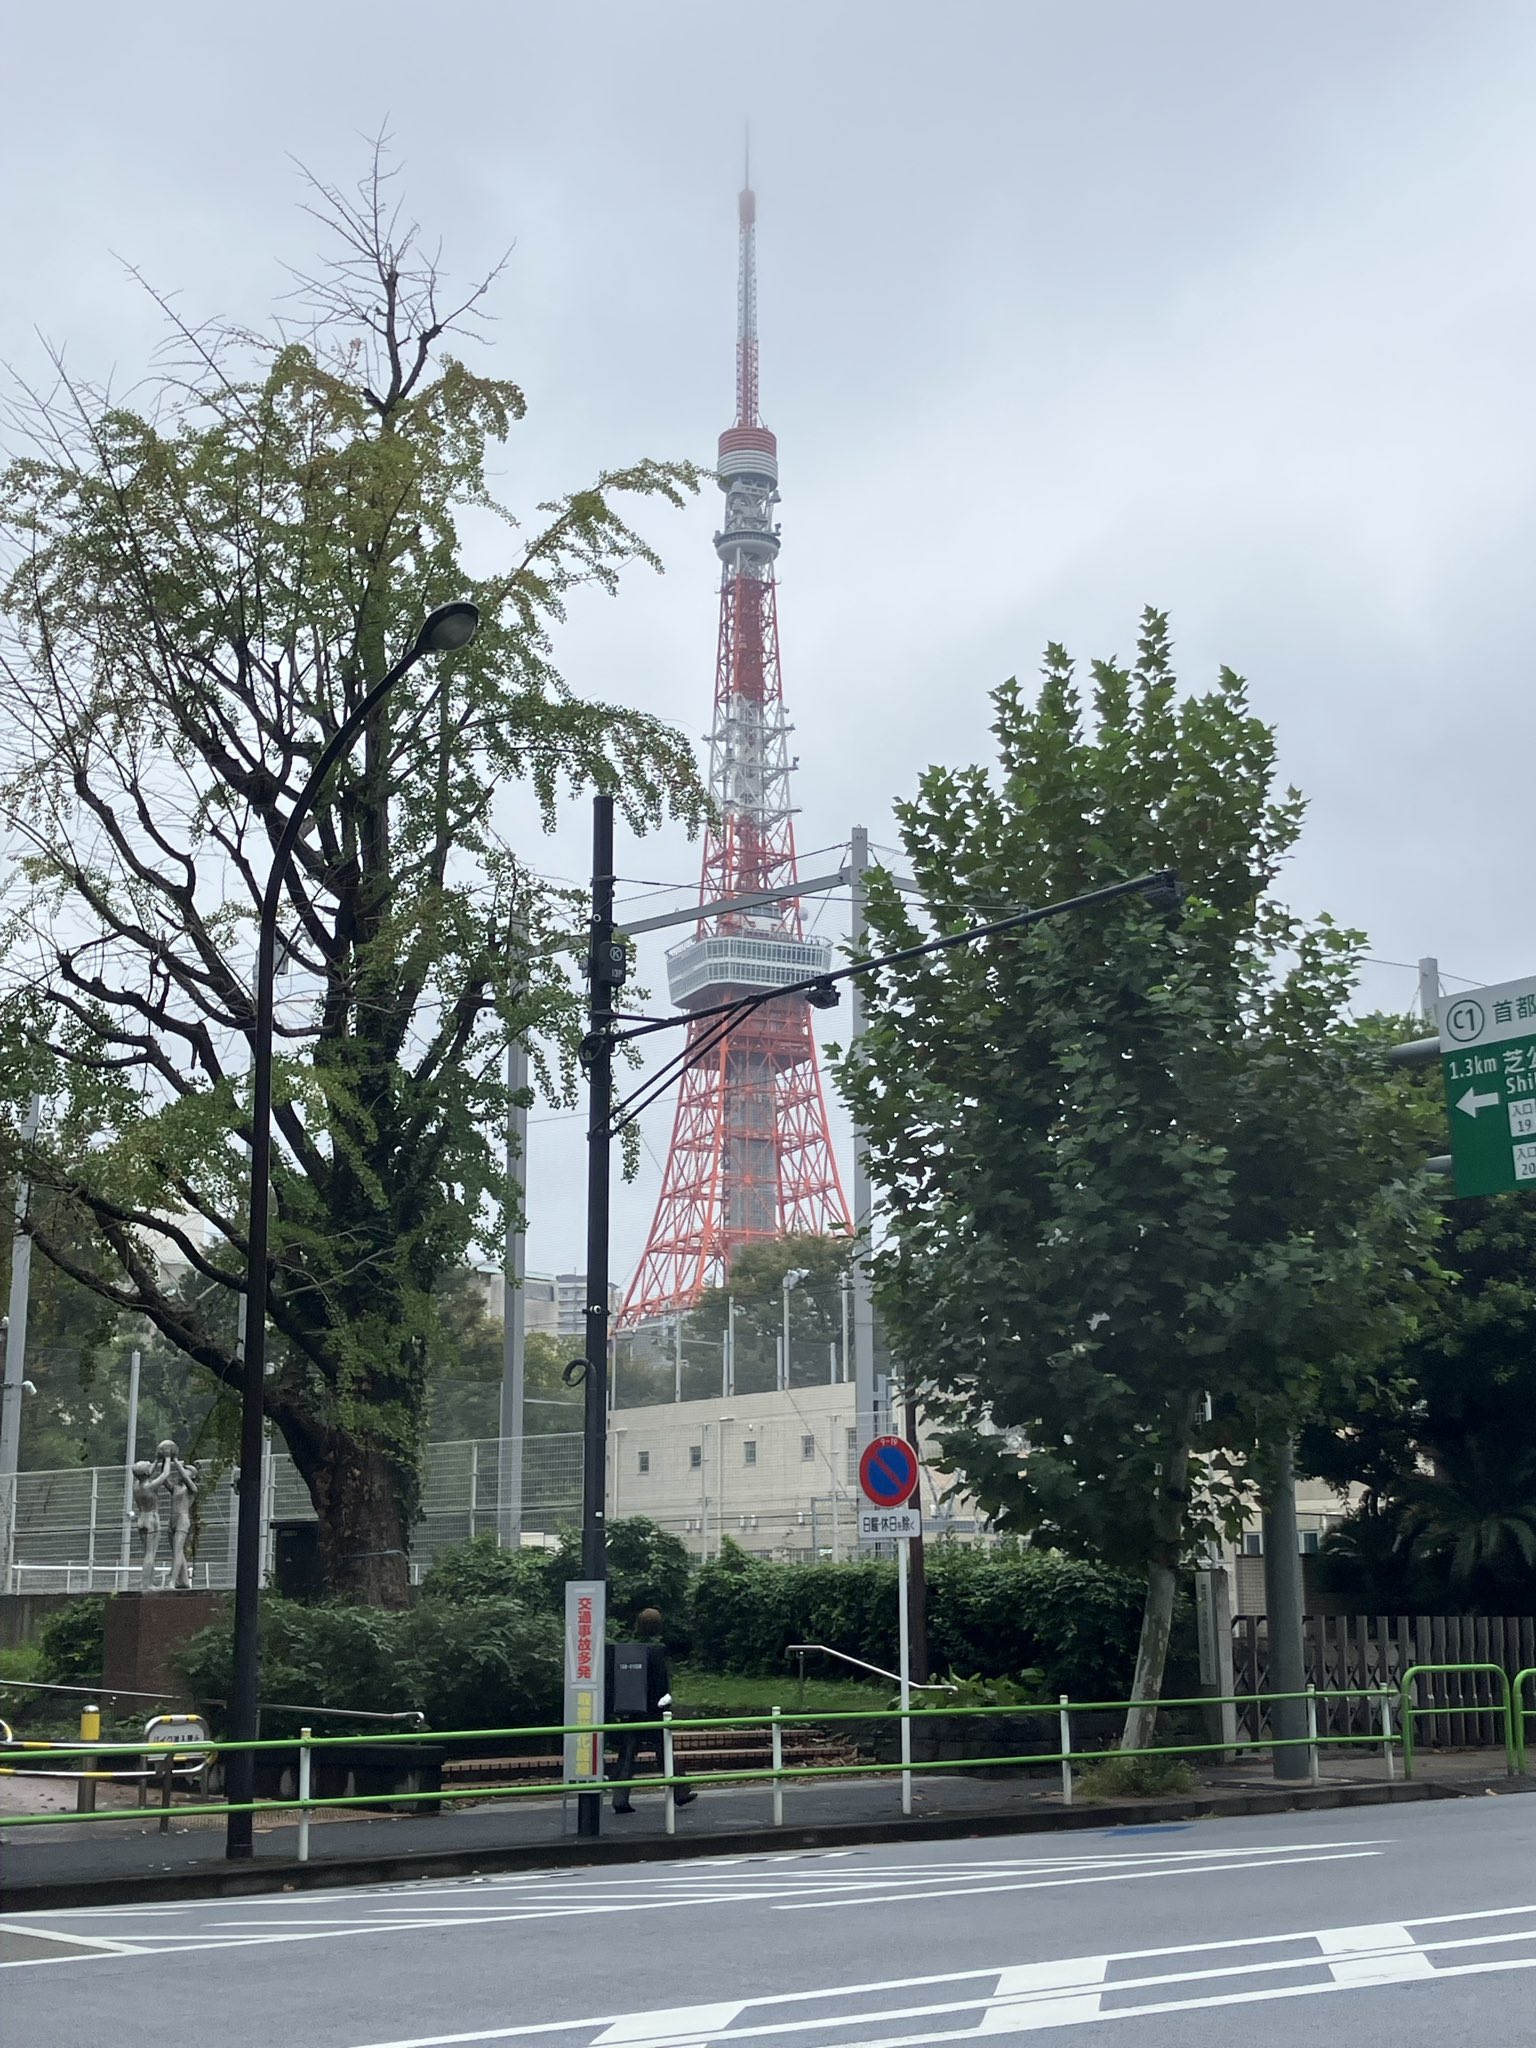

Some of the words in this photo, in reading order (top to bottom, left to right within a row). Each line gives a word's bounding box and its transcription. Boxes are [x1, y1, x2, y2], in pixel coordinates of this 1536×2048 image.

[1454, 1008, 1475, 1031] C1
[1449, 1056, 1497, 1080] 1.3km
[1511, 1103, 1533, 1118] 入口
[1518, 1118, 1532, 1133] 19
[1521, 1162, 1536, 1176] 20
[577, 1597, 592, 1679] 交通事故多発
